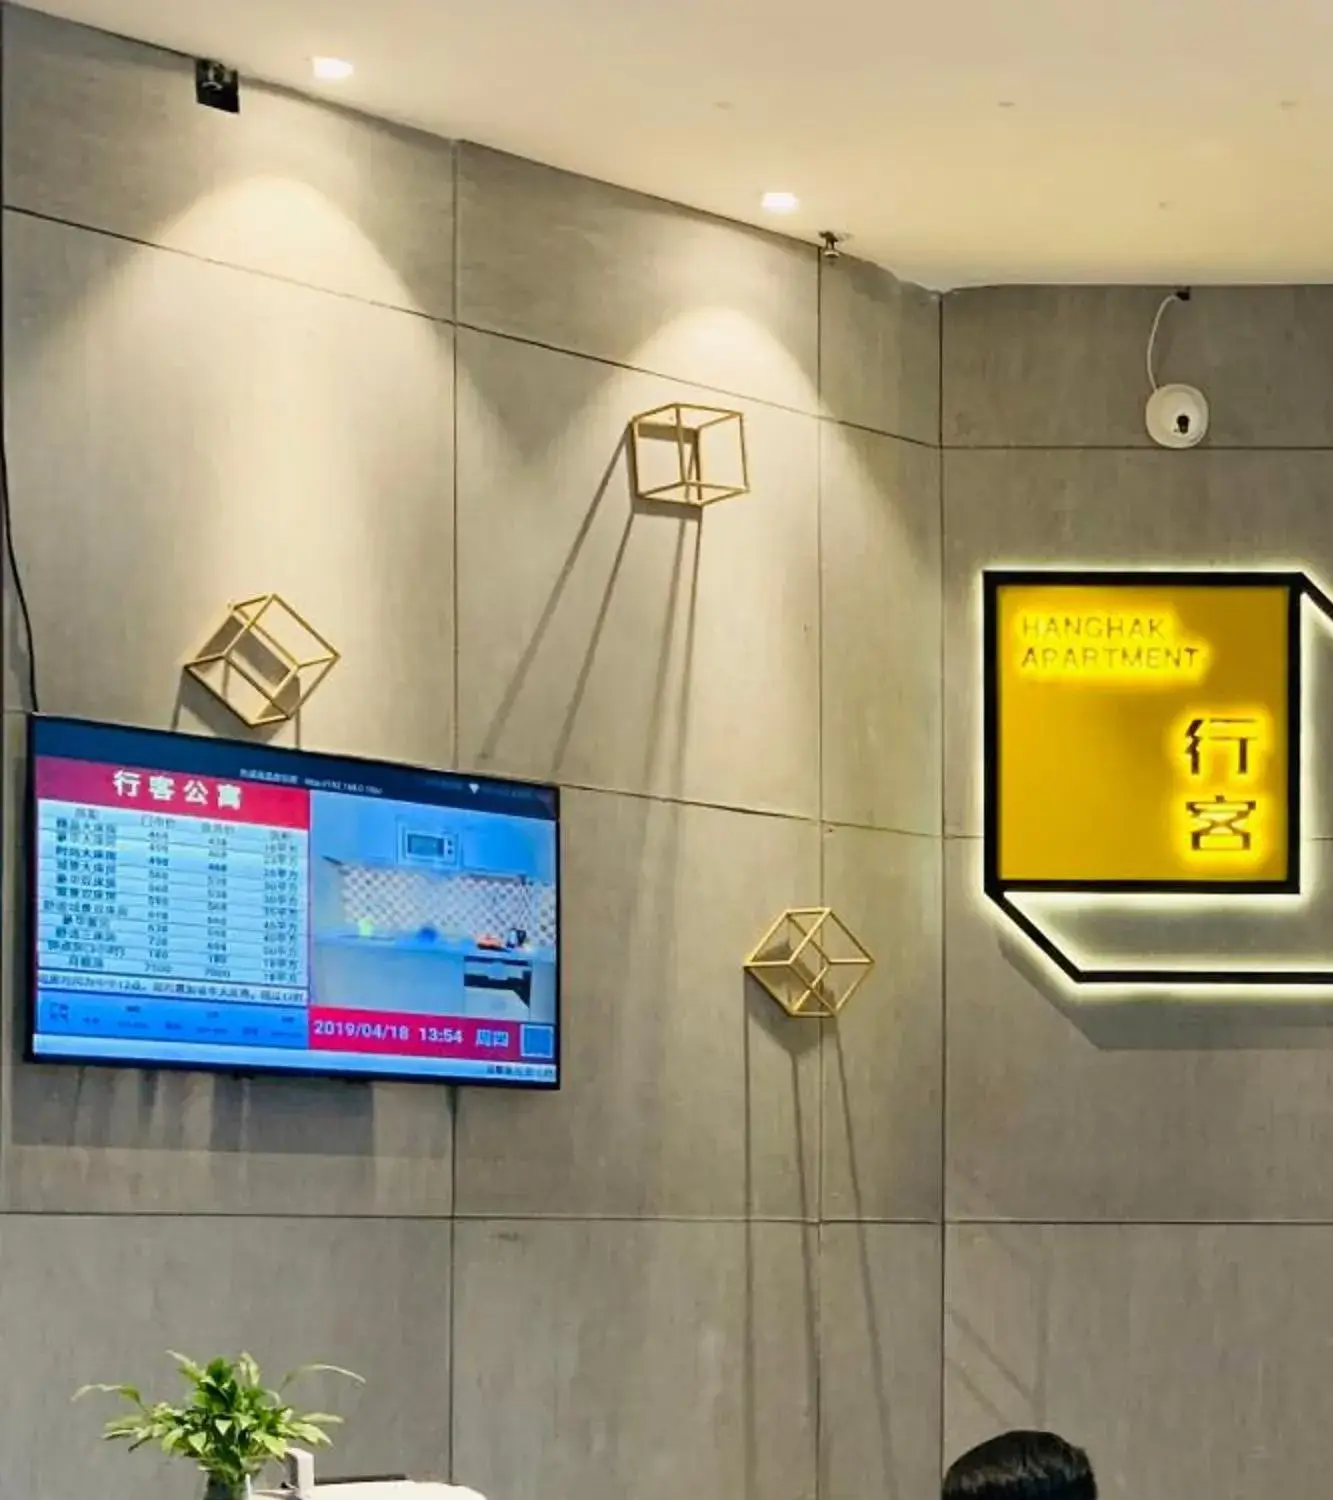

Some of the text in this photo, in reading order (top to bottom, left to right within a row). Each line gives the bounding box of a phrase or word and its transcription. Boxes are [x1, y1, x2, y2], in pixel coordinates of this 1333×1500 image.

[1023, 616, 1165, 639] HANGHAK
[1022, 647, 1198, 669] APARTMENT
[113, 769, 241, 810] 行客公寓
[1185, 719, 1257, 851] 行客
[314, 1019, 409, 1041] 2019/04/18
[418, 1027, 463, 1044] 13:54
